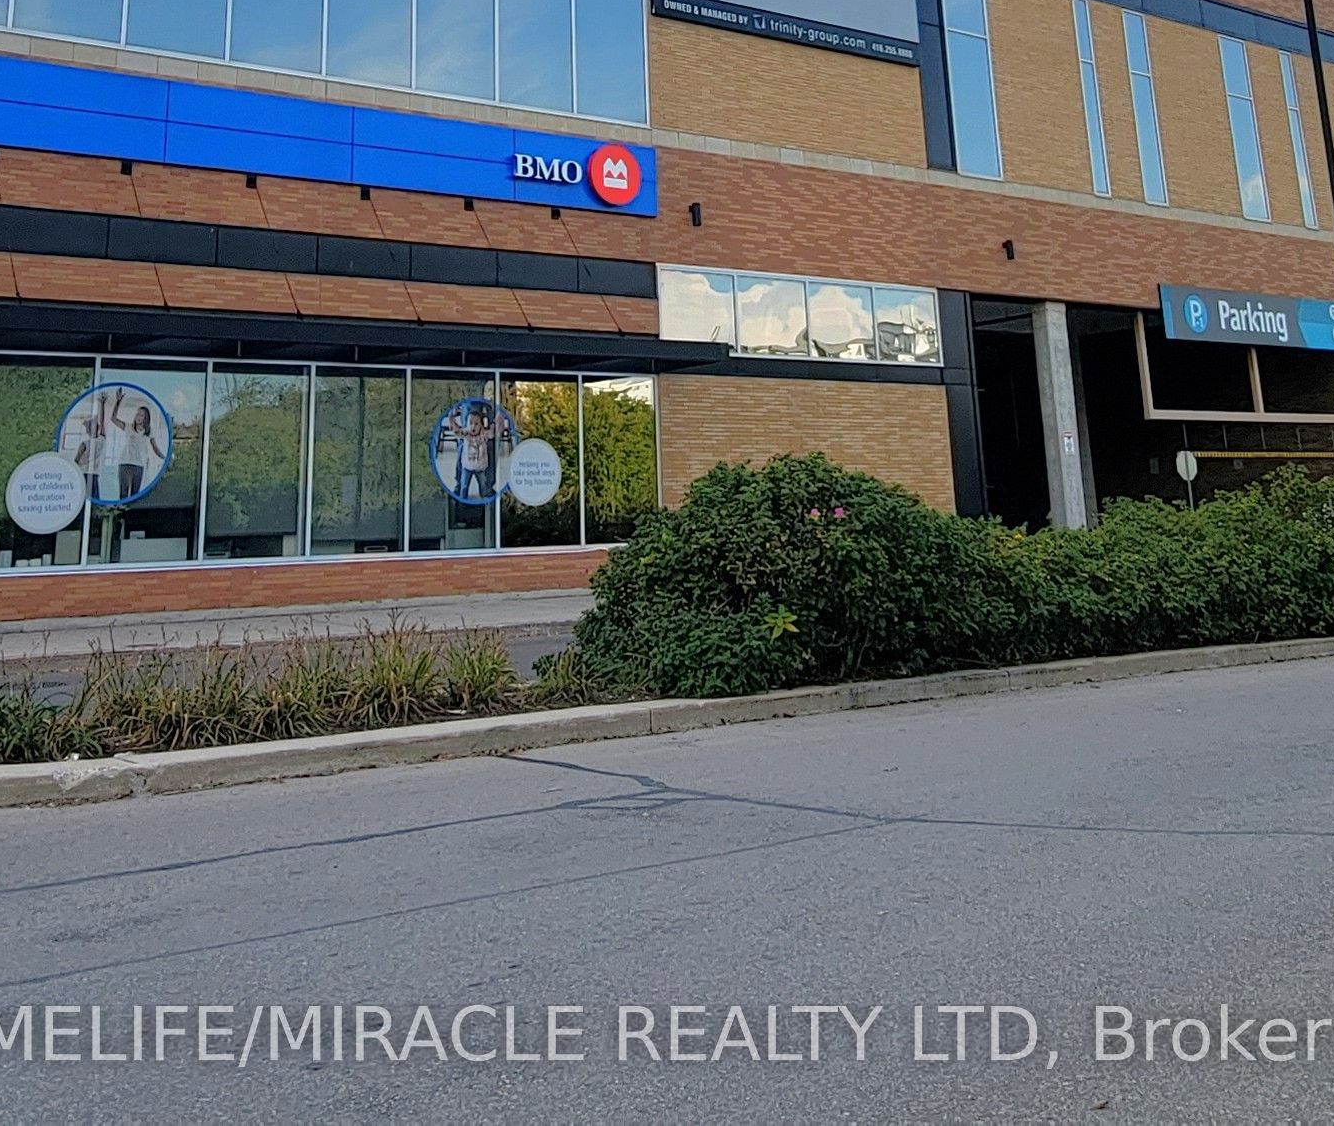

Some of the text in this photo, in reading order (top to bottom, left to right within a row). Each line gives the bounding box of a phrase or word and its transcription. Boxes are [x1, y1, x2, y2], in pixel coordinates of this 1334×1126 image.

[663, 0, 749, 26] OWNED & MANAGED BY
[769, 19, 867, 50] trinity-group.com
[514, 153, 584, 184] BMO
[1217, 299, 1289, 343] Parking
